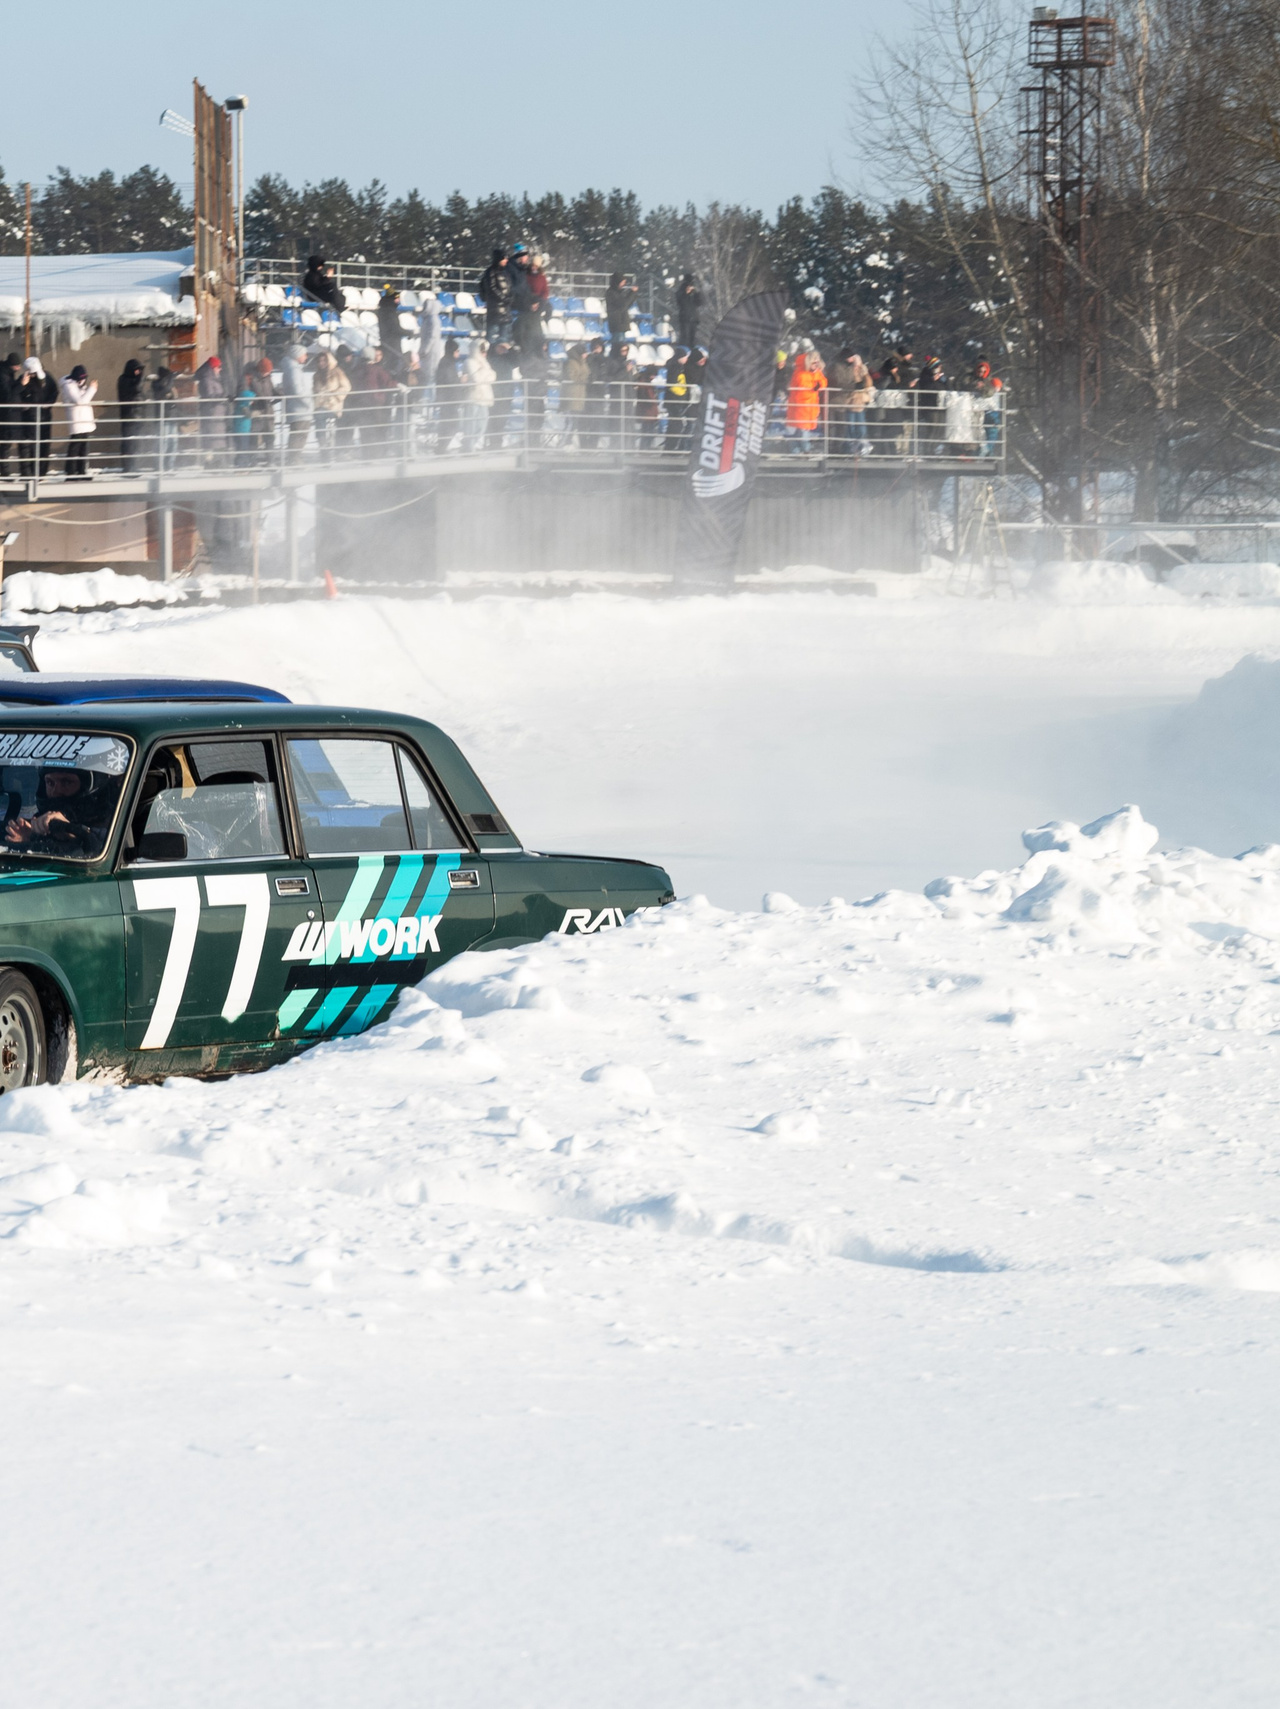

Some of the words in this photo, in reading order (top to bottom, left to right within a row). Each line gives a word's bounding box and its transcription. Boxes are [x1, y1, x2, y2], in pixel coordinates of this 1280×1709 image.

[699, 392, 728, 470] DRIFT
[733, 401, 754, 462] TRACK
[748, 400, 767, 456] MODE
[8, 733, 91, 760] MODE
[133, 873, 270, 1050] 77
[340, 914, 444, 959] WORK
